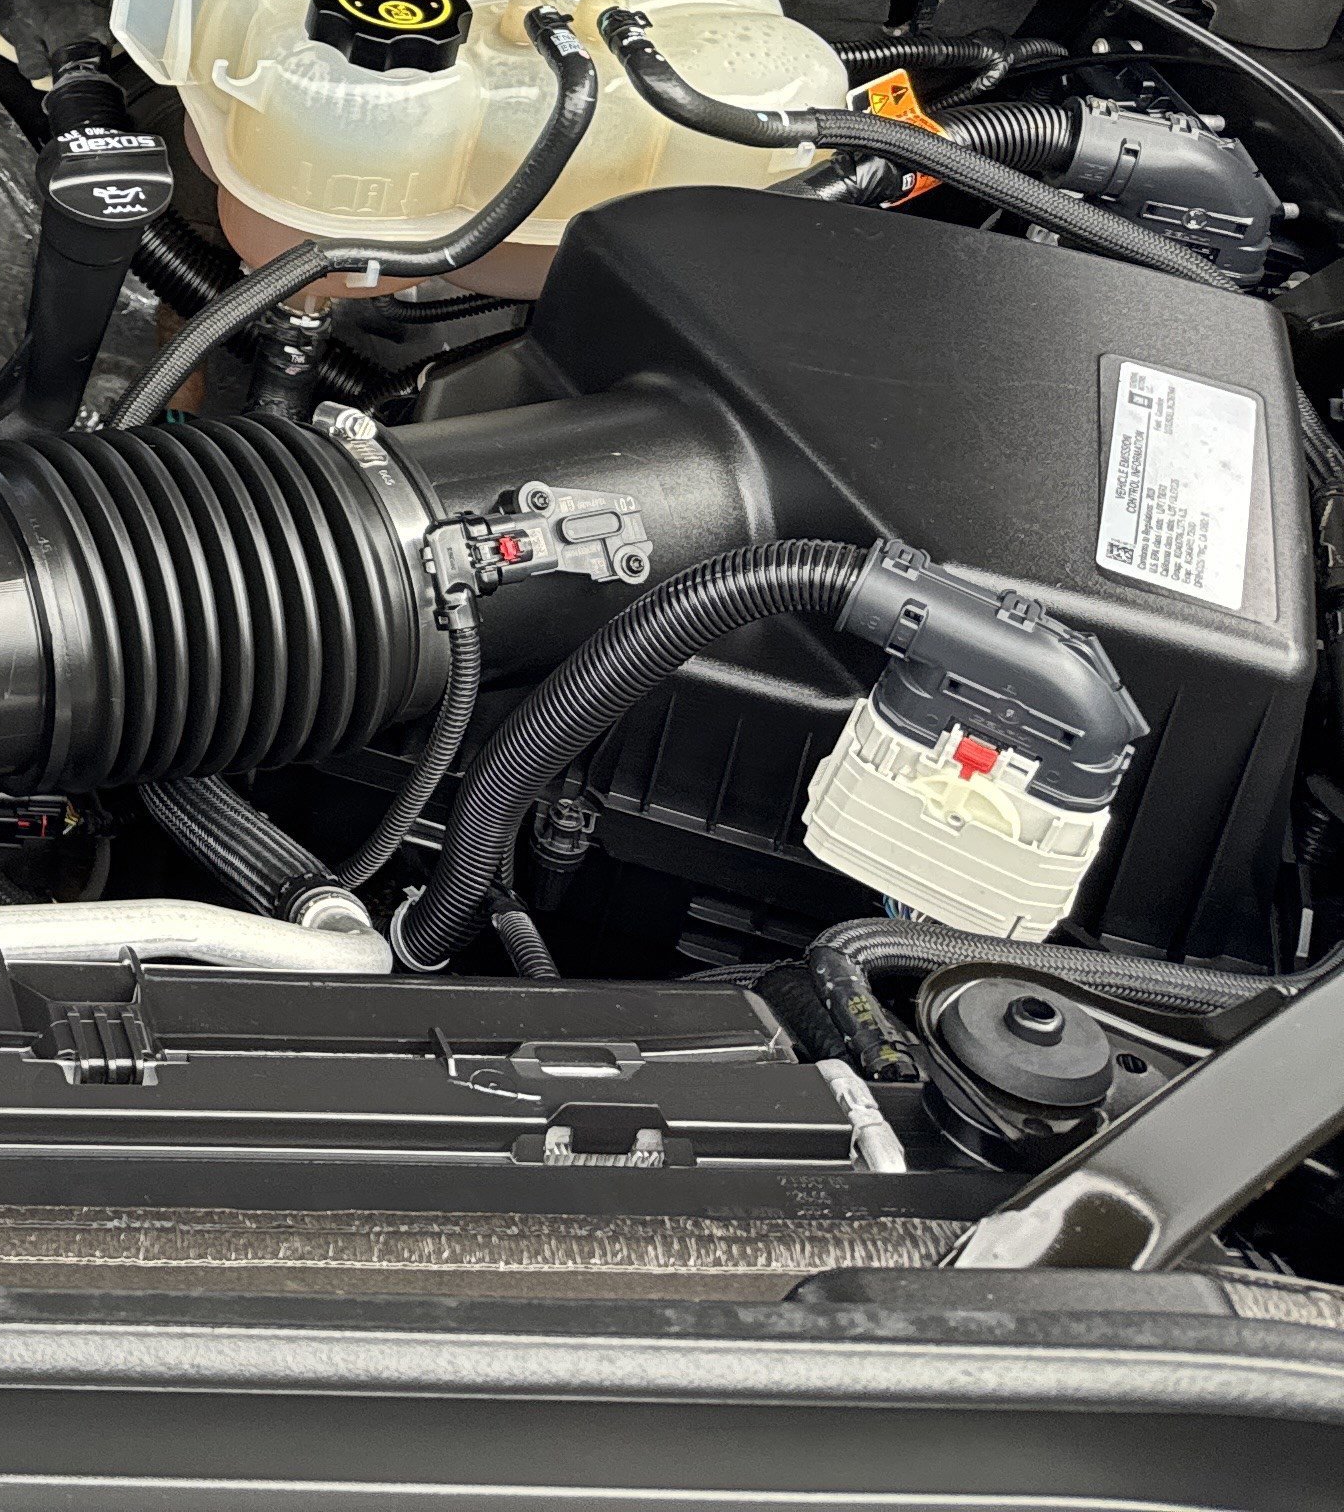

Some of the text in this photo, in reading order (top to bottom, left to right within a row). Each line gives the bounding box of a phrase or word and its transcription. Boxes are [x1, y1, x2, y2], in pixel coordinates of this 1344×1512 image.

[69, 135, 156, 153] dexos
[1115, 433, 1131, 500] VEHICLE EMISSION
[1126, 430, 1143, 513] CONTROL INFORMATION
